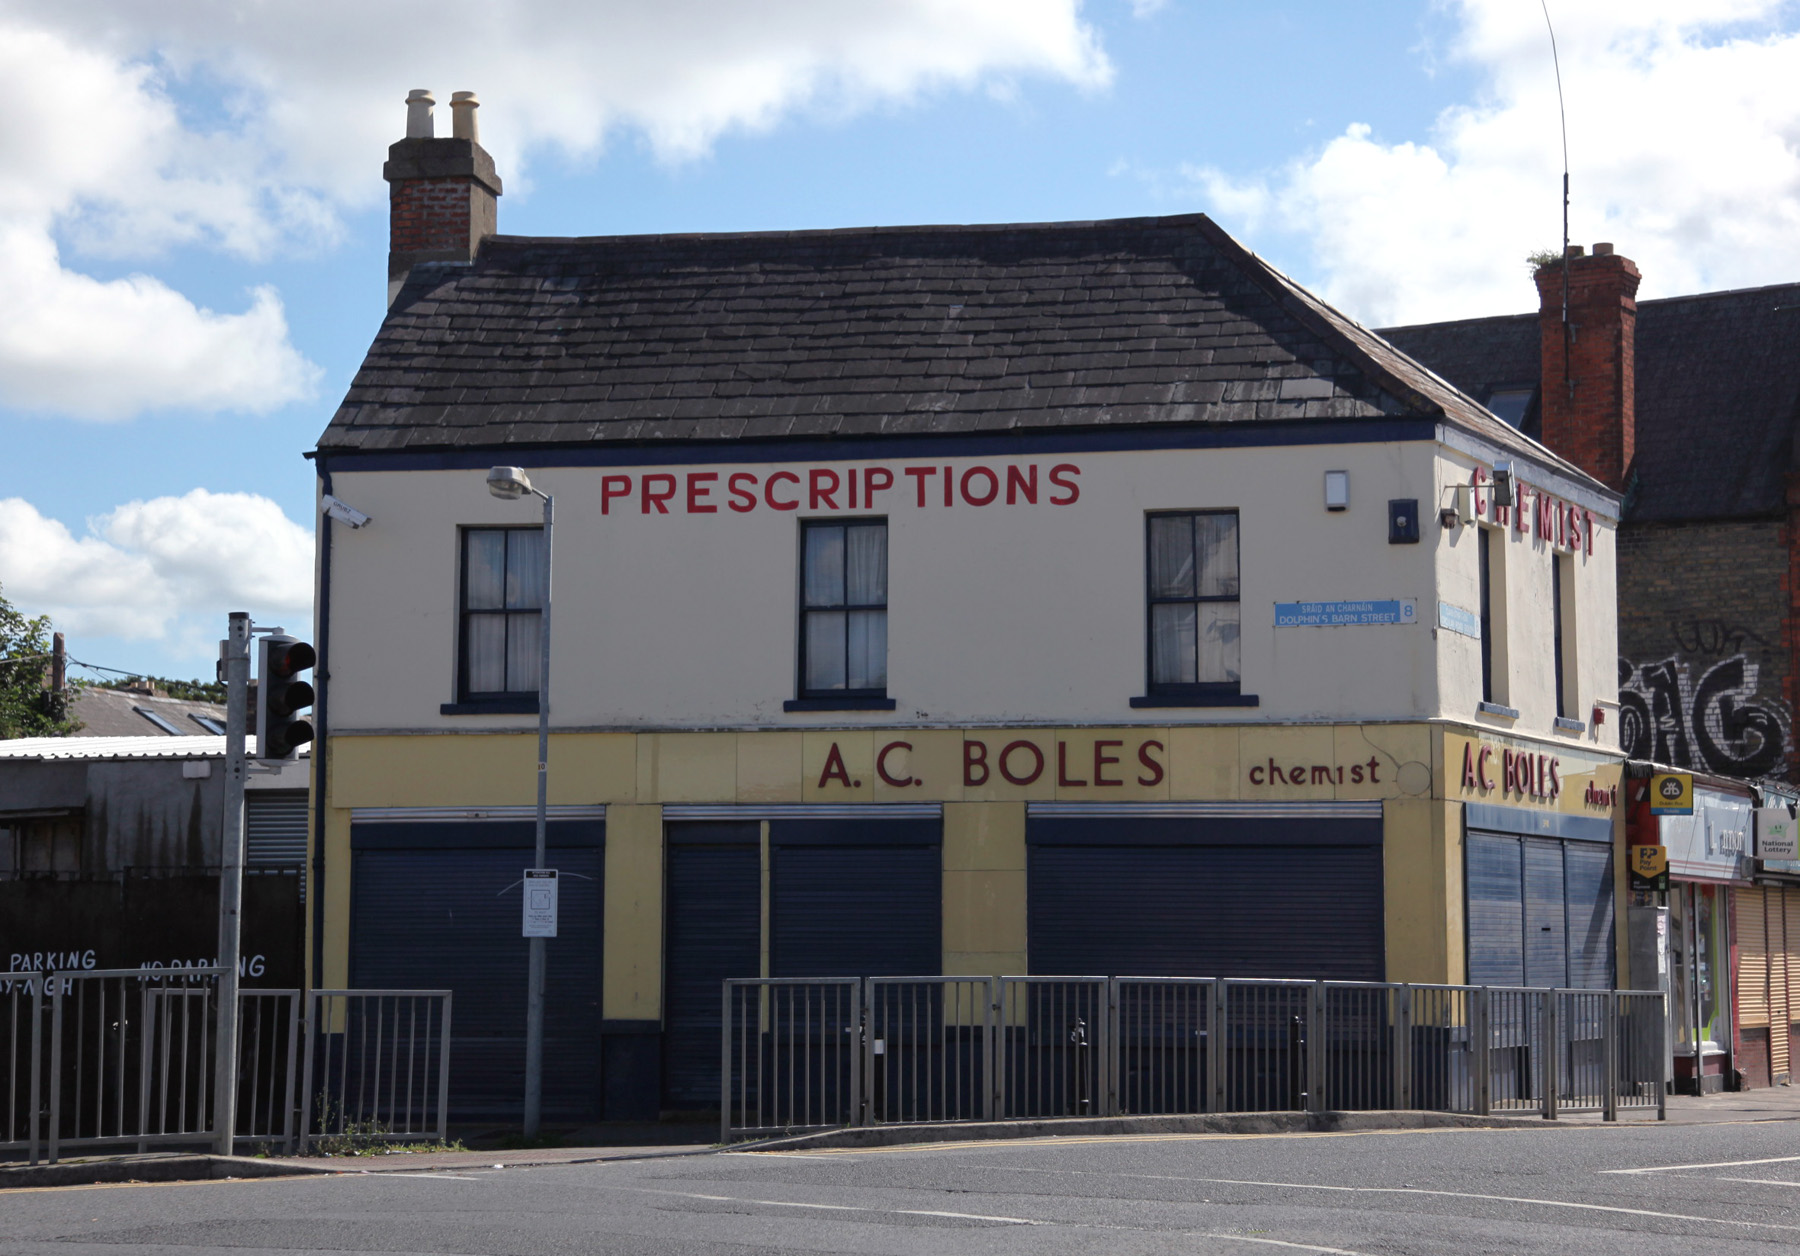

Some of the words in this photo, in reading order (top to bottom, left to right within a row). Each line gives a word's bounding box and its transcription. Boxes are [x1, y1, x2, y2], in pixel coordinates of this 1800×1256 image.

[601, 464, 1081, 515] PRESCRIPTIONS
[1279, 614, 1328, 625] DOLPHIN'S
[1331, 614, 1358, 623] BARN
[1361, 612, 1396, 623] STREET
[1301, 603, 1322, 614] SRÁID
[1326, 604, 1335, 613] AN
[1337, 601, 1373, 612] CHARNÁIN
[1404, 605, 1413, 617] 8
[963, 739, 1165, 788] BOLES
[1249, 755, 1381, 786] chemist
[1504, 748, 1560, 799] BOLES
[1764, 846, 1791, 855] Lottery
[10, 949, 97, 972] PARKING
[137, 960, 164, 982] NO
[168, 954, 266, 983] PARNG
